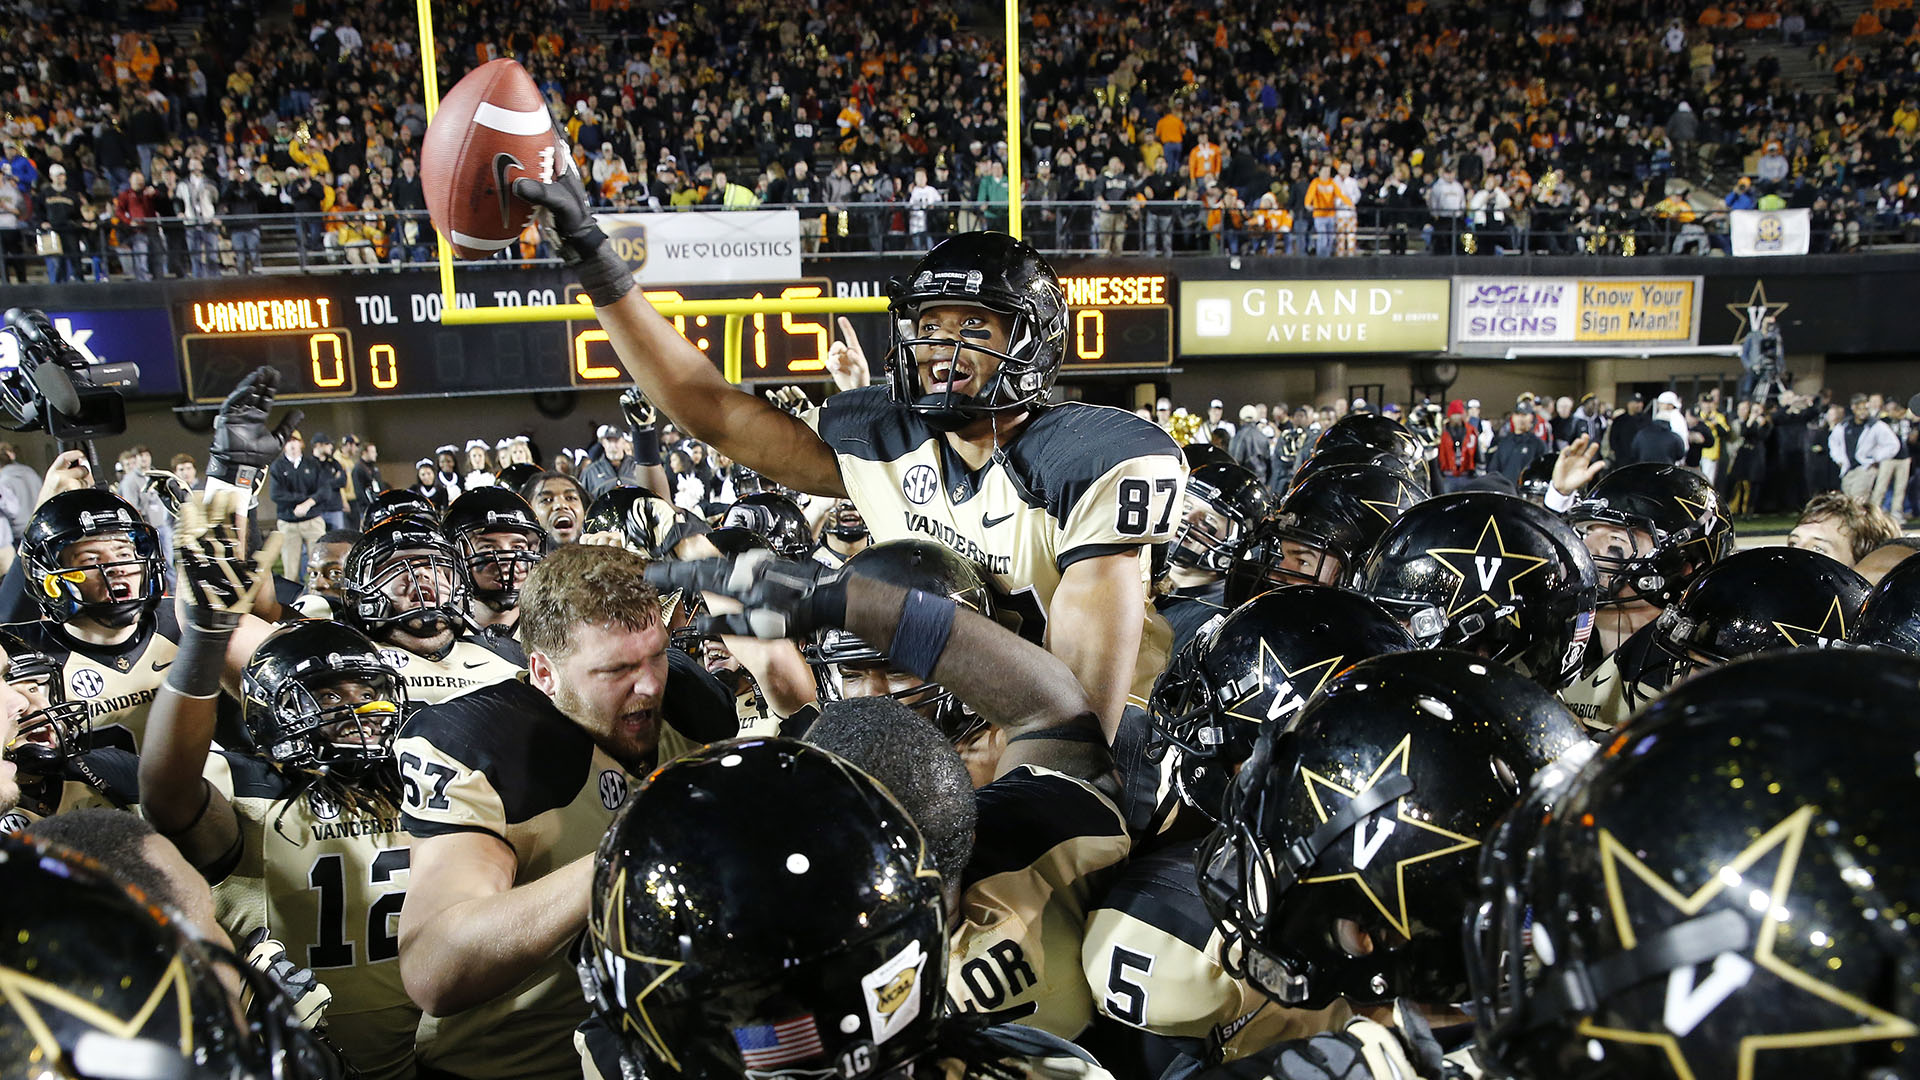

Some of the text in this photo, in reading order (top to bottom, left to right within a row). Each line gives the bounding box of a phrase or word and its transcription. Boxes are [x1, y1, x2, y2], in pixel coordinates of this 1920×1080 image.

[665, 241, 793, 259] WE LOGISTICS
[356, 295, 398, 325] TOL
[411, 292, 476, 323] DON
[1242, 288, 1392, 317] GRAND
[1468, 285, 1563, 304] JOSLIN
[1583, 286, 1683, 305] Know Your
[194, 299, 331, 333] VANDERBILT
[1077, 310, 1104, 360] 0
[1266, 323, 1368, 342] AVENUE
[1471, 317, 1557, 332] SIGNS
[1582, 311, 1680, 333] Sign Man!!
[310, 333, 344, 388] 0
[369, 344, 398, 389] 0
[903, 465, 938, 504] SEC
[1113, 475, 1179, 537] 87
[904, 511, 1011, 574] VANDERBILT
[1475, 555, 1502, 592] V
[72, 669, 104, 698] SEC
[1266, 681, 1306, 721] V
[400, 751, 459, 812] 67
[600, 771, 627, 809] SEC
[1353, 816, 1397, 871] V
[307, 847, 411, 969] 12
[1105, 942, 1156, 1027] 5
[1663, 951, 1754, 1037] V
